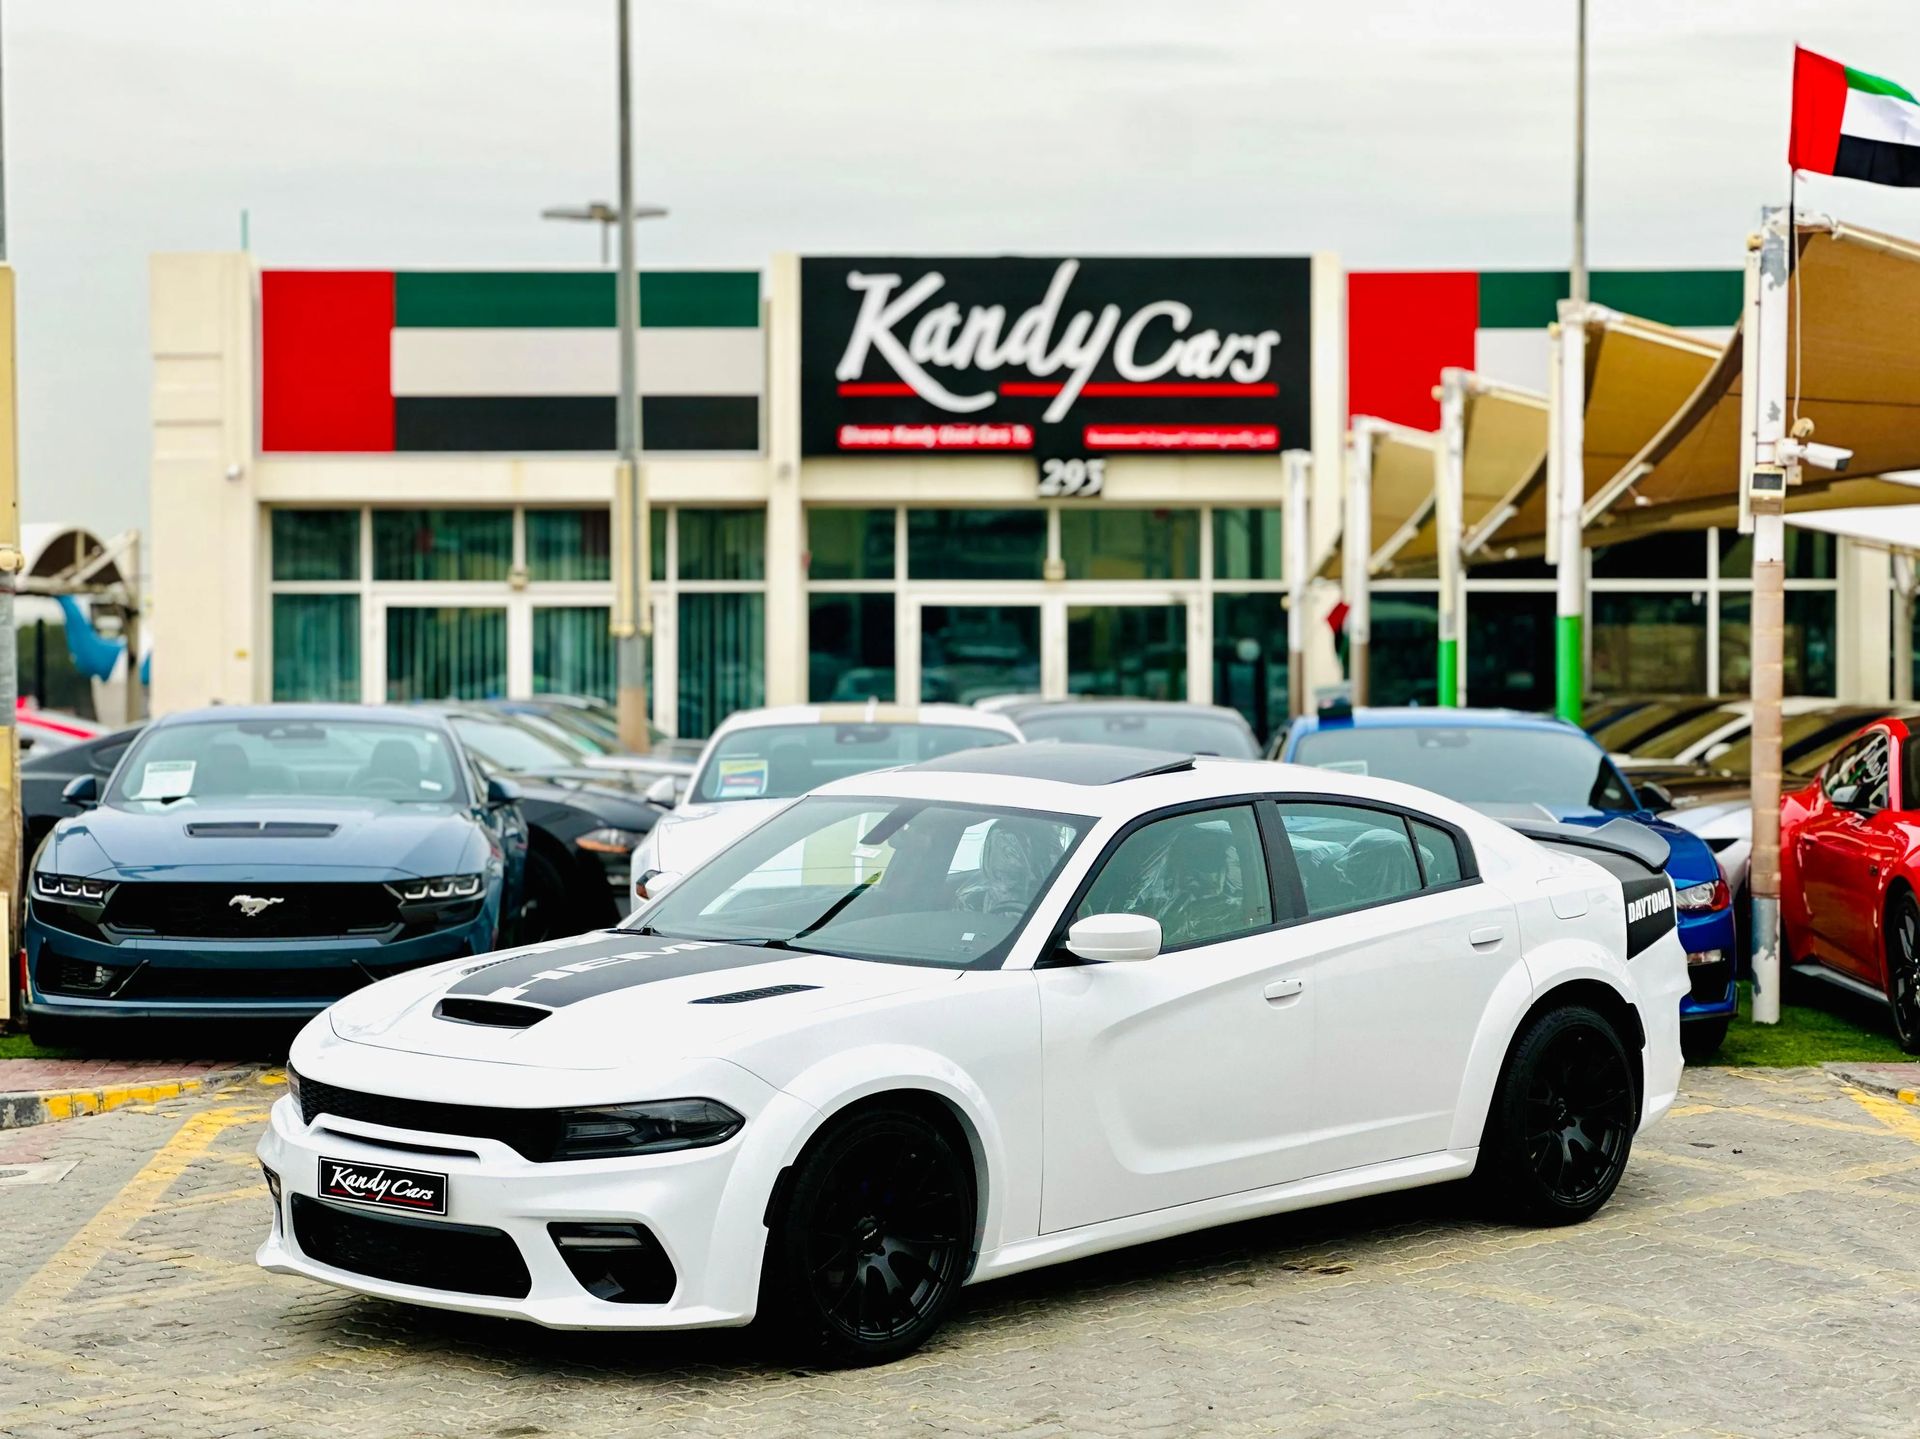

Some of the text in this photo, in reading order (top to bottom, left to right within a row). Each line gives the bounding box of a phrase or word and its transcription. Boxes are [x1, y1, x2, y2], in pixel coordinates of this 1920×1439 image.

[835, 258, 1281, 422] Kandy Cars
[1627, 887, 1672, 924] DAYTONA
[329, 1165, 434, 1201] Kandy Cars
